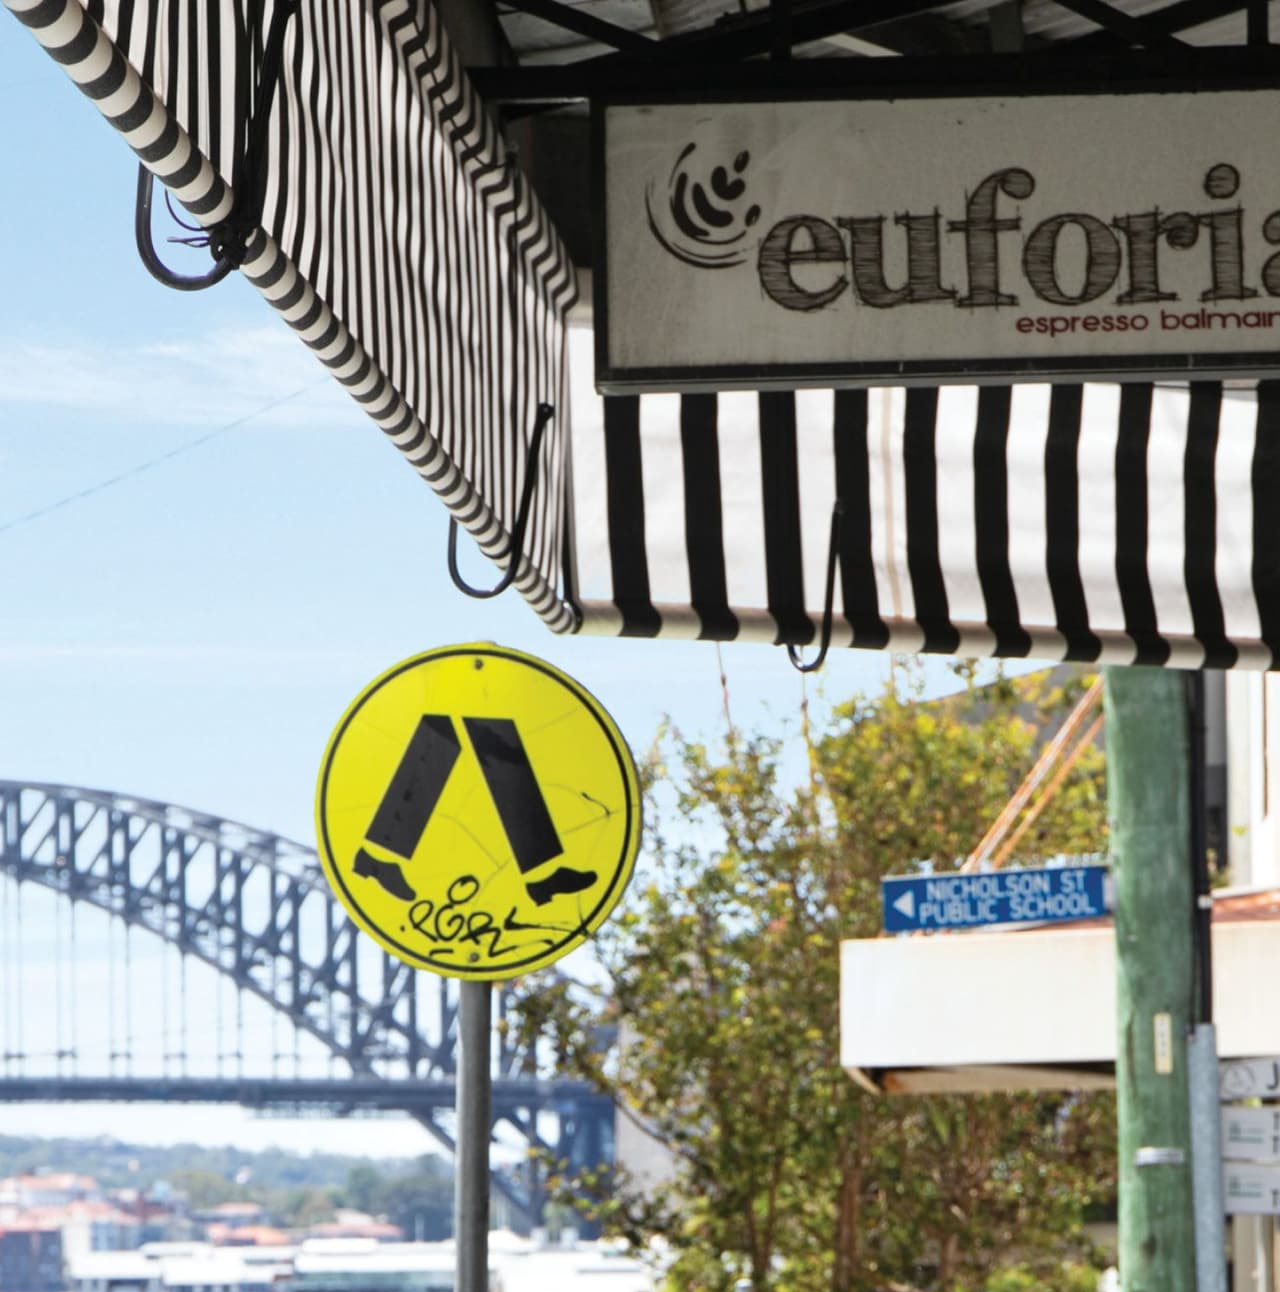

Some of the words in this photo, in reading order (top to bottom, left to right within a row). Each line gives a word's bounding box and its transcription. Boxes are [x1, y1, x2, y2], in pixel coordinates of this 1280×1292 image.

[1016, 311, 1149, 338] espresso
[926, 875, 1050, 901] NICHOLSON
[1059, 869, 1087, 894] ST
[919, 898, 999, 925] PUBLIC
[1009, 893, 1098, 919] SCHOOL
